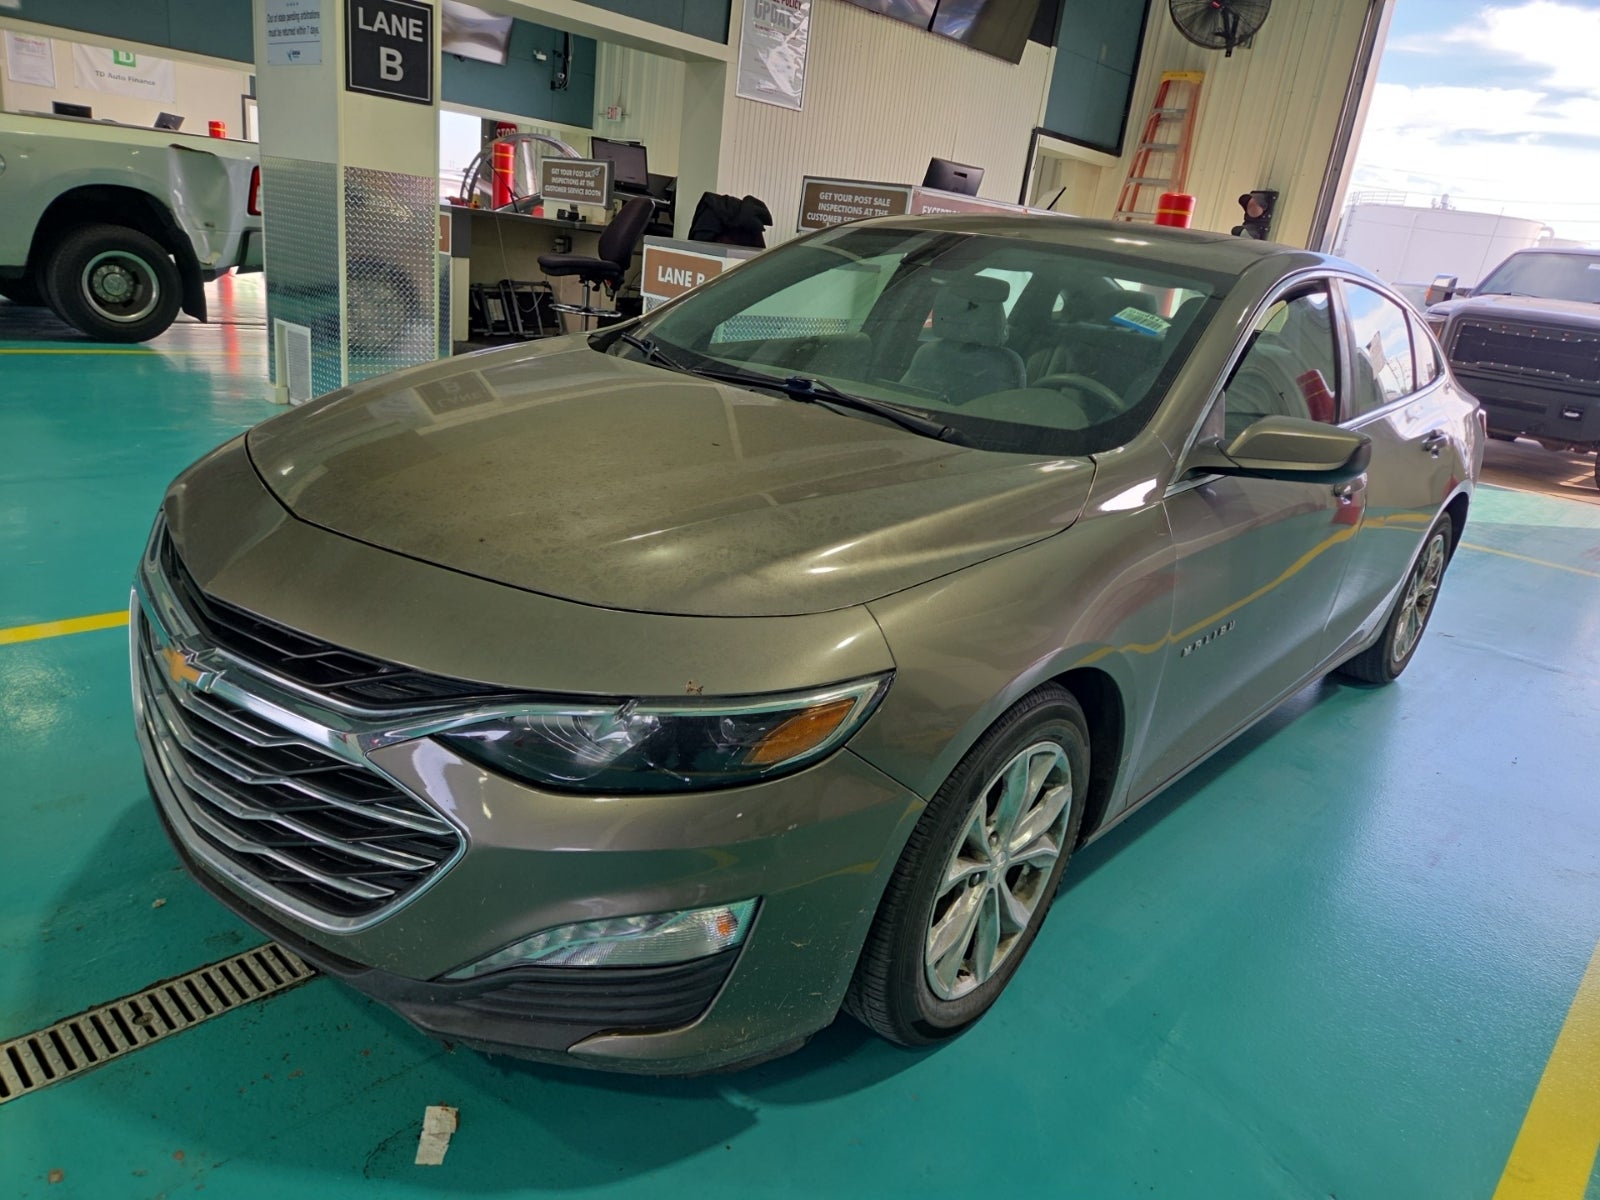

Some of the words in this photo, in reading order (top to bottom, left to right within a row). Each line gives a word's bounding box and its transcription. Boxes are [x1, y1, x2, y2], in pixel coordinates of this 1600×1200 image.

[358, 6, 424, 43] LANE
[379, 46, 404, 82] B
[95, 69, 105, 78] TD
[108, 71, 126, 82] Auto
[128, 75, 156, 87] Finance
[819, 191, 832, 200] GET
[833, 193, 853, 203] YOUR
[854, 195, 872, 205] POST
[873, 197, 891, 207] SALE
[806, 212, 842, 224] CUSTOMER
[817, 202, 863, 215] INSPECTIONS
[863, 208, 874, 217] AT
[874, 209, 889, 217] THE
[657, 265, 693, 288] LANE
[1180, 620, 1236, 658] MALIBU
